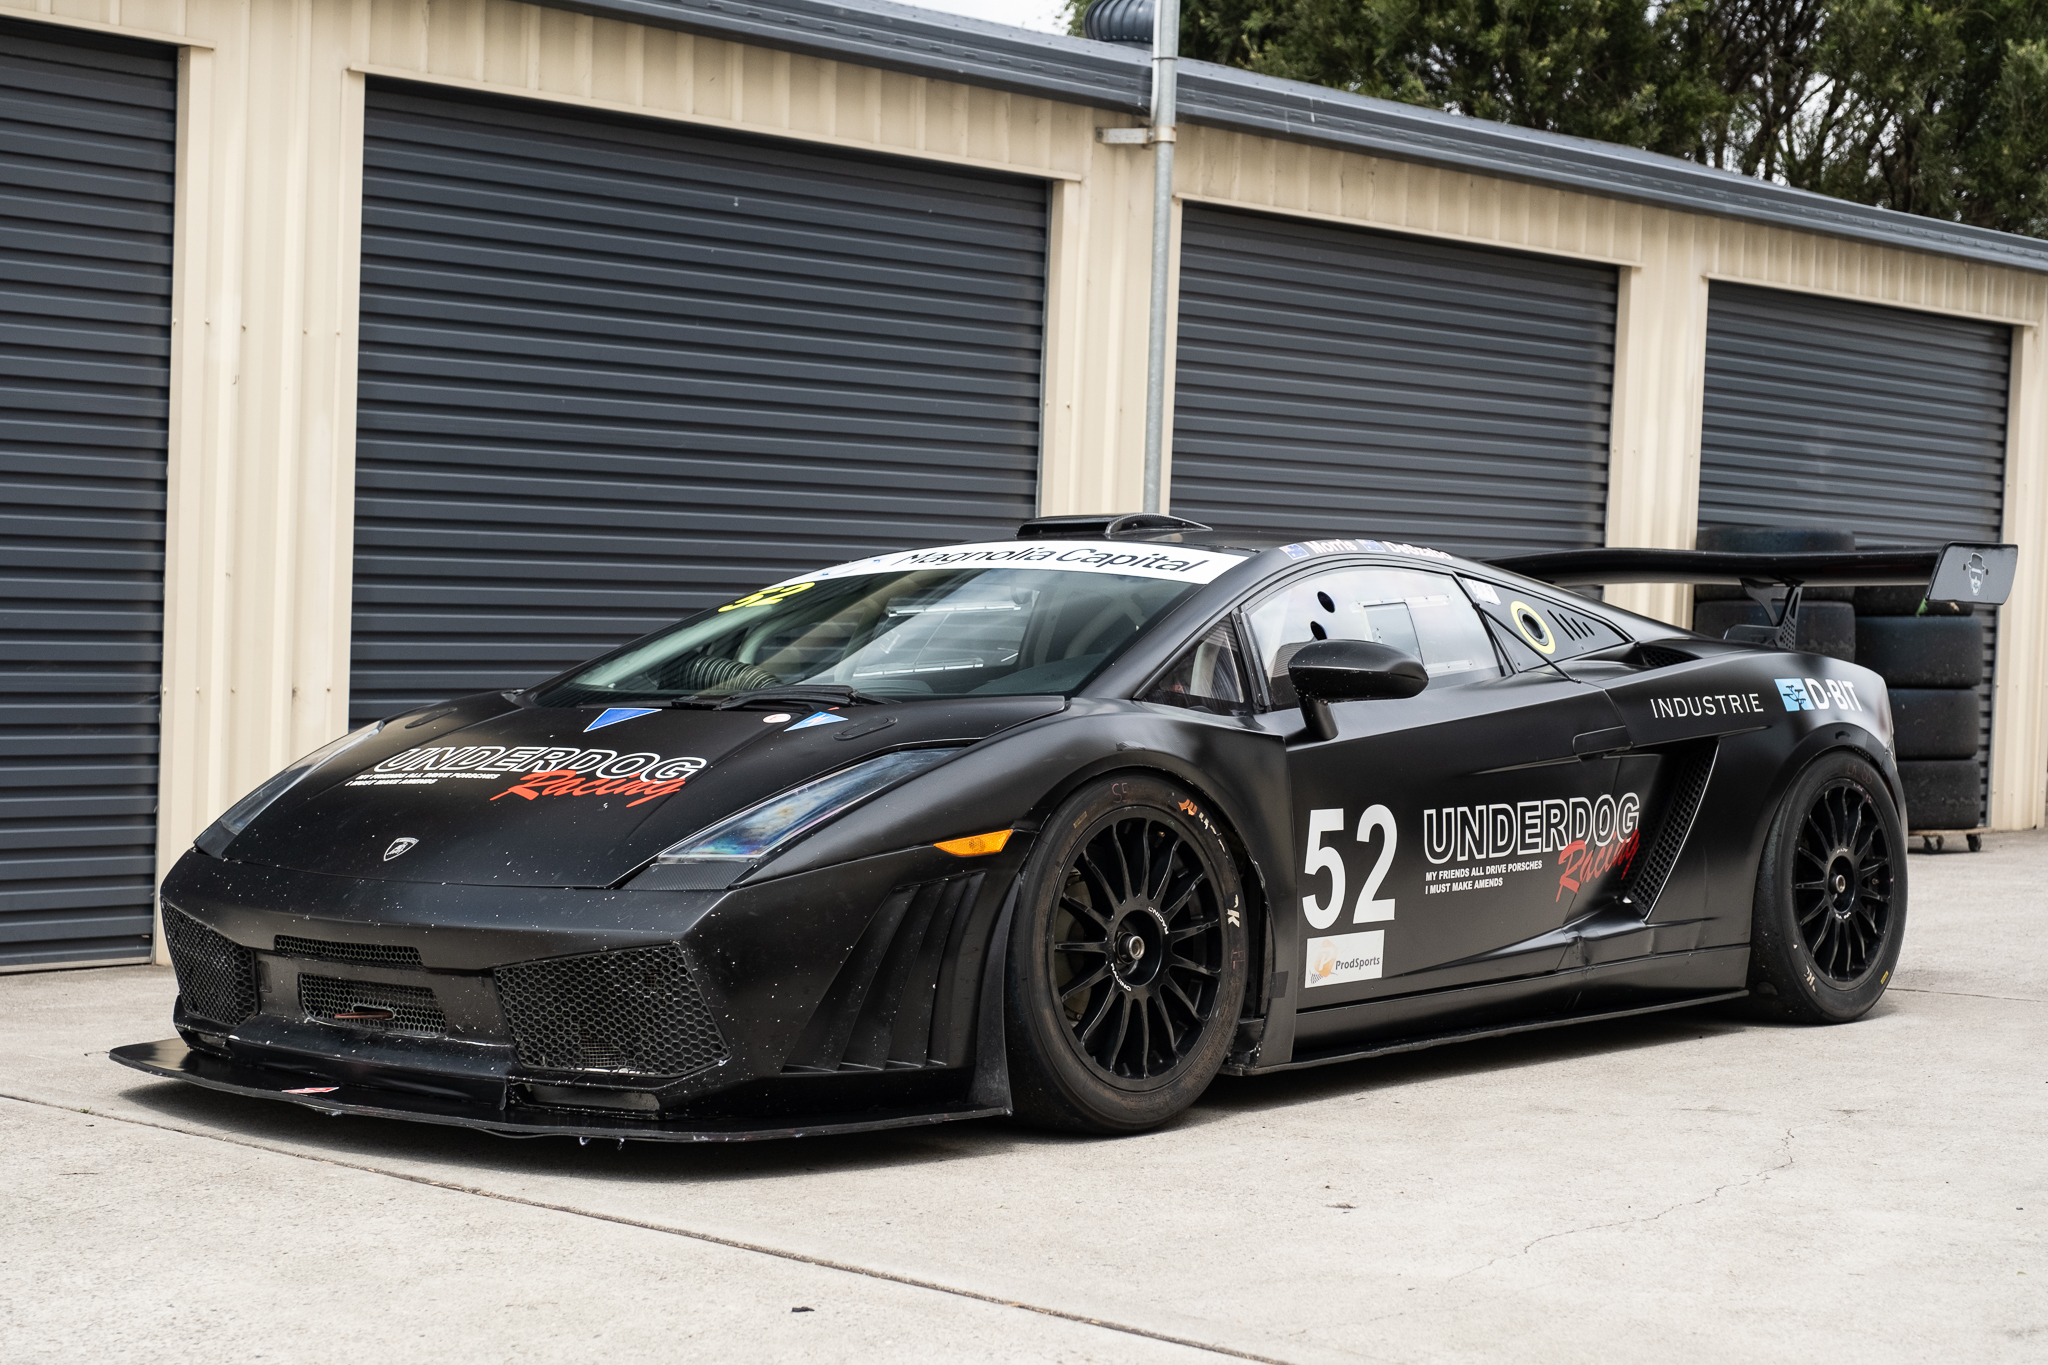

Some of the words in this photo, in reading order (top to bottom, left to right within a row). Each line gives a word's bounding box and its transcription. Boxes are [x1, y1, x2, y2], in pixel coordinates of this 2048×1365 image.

[890, 547, 1051, 566] Magnolia
[1056, 549, 1209, 572] Capital
[1303, 539, 1359, 554] Morris
[718, 582, 815, 612] 52
[1650, 693, 1764, 718] INDUSTRIE
[374, 746, 707, 783] UNDERDOG
[489, 769, 686, 808] Racing
[1423, 792, 1640, 864] UNDERDOG
[1302, 804, 1397, 929] 52
[1425, 871, 1438, 881] MY
[1438, 867, 1470, 880] FRIENDS
[1470, 866, 1485, 877] ALL
[1485, 864, 1507, 874] DRIVE
[1507, 860, 1543, 872] PORSCHES
[1555, 828, 1640, 903] Racing
[1425, 885, 1429, 895] I
[1429, 883, 1451, 894] MUST
[1451, 881, 1473, 892] MAKE
[1473, 877, 1504, 889] AMENDS
[1148, 906, 1170, 935] RACING
[1335, 956, 1381, 971] ProdSports
